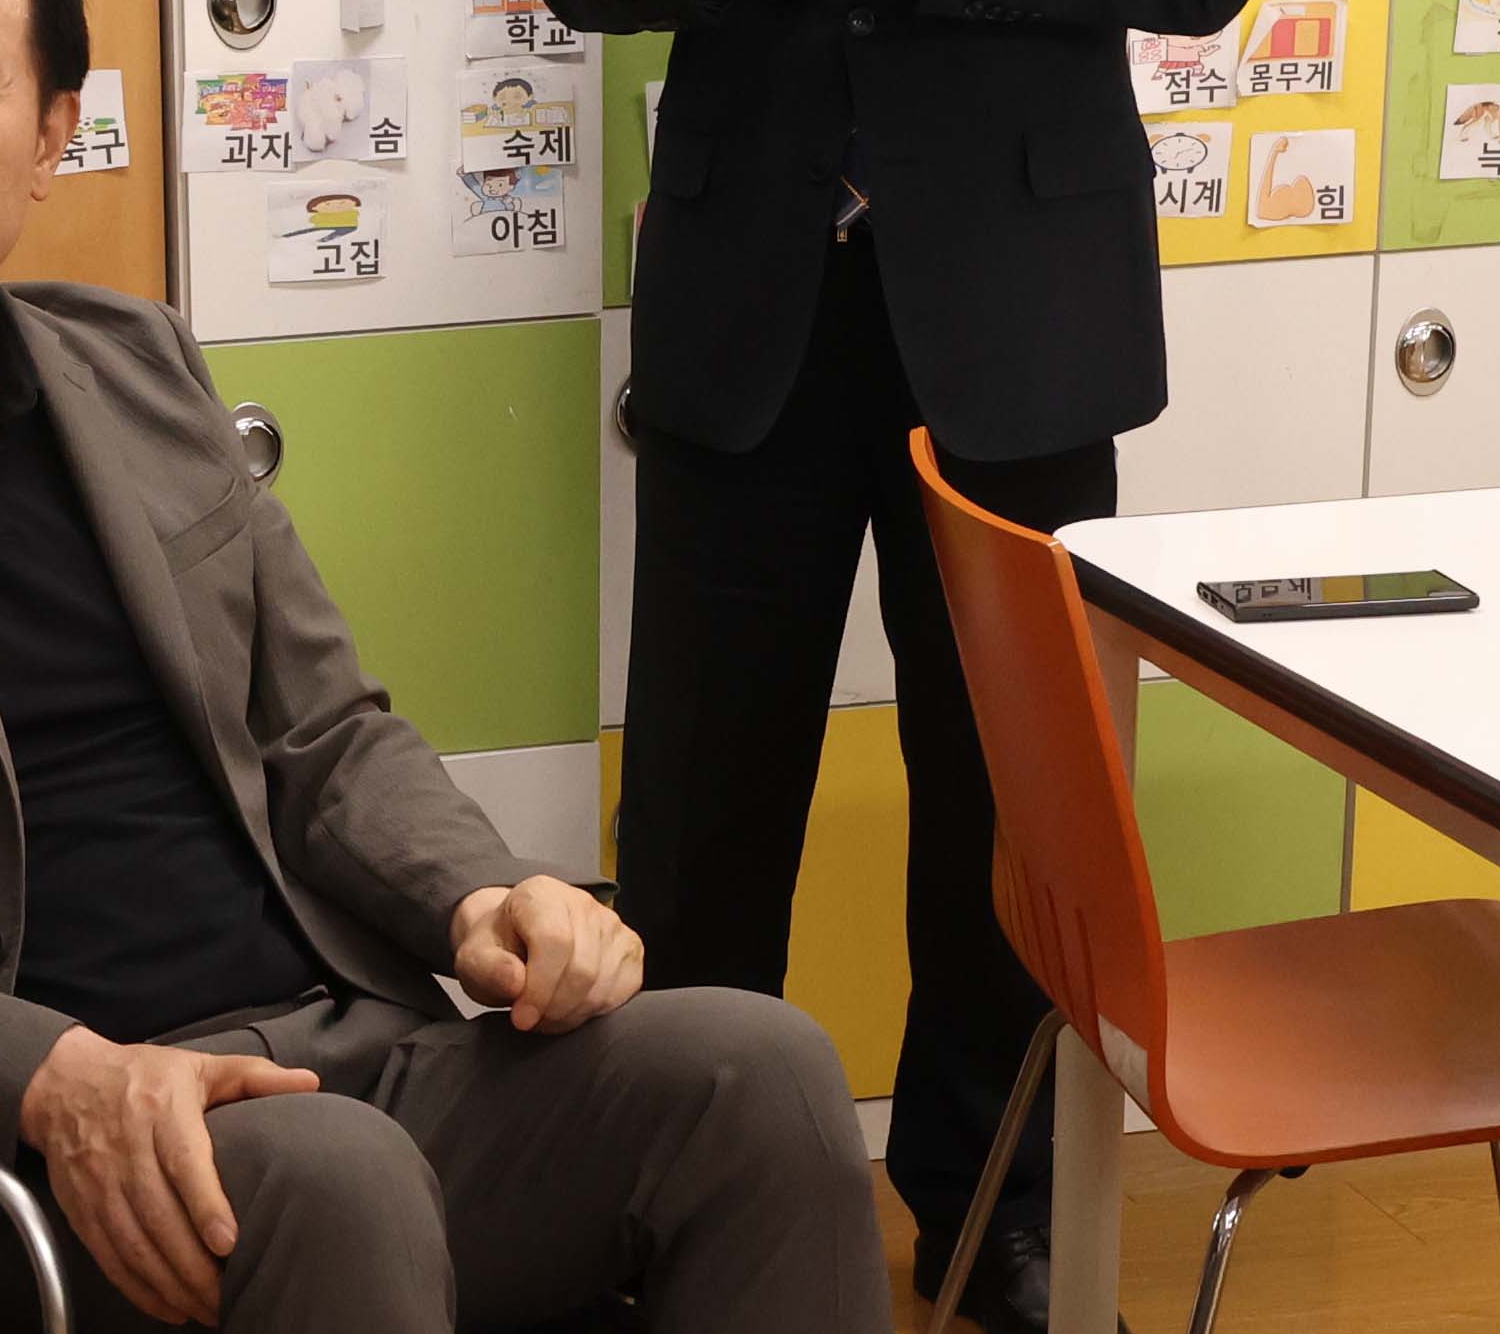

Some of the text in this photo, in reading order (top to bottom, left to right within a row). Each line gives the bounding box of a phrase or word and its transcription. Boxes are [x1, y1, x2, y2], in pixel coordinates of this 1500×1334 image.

[505, 15, 576, 52] 학교
[1165, 68, 1229, 104] 점수
[1248, 60, 1334, 94] 몸무게
[221, 131, 293, 169] 과자
[369, 117, 404, 155] 솜
[502, 125, 573, 165] 숙제
[1158, 177, 1223, 215] 시계
[1316, 185, 1346, 221] 힘
[490, 208, 558, 249] 아침
[312, 238, 382, 276] 고집
